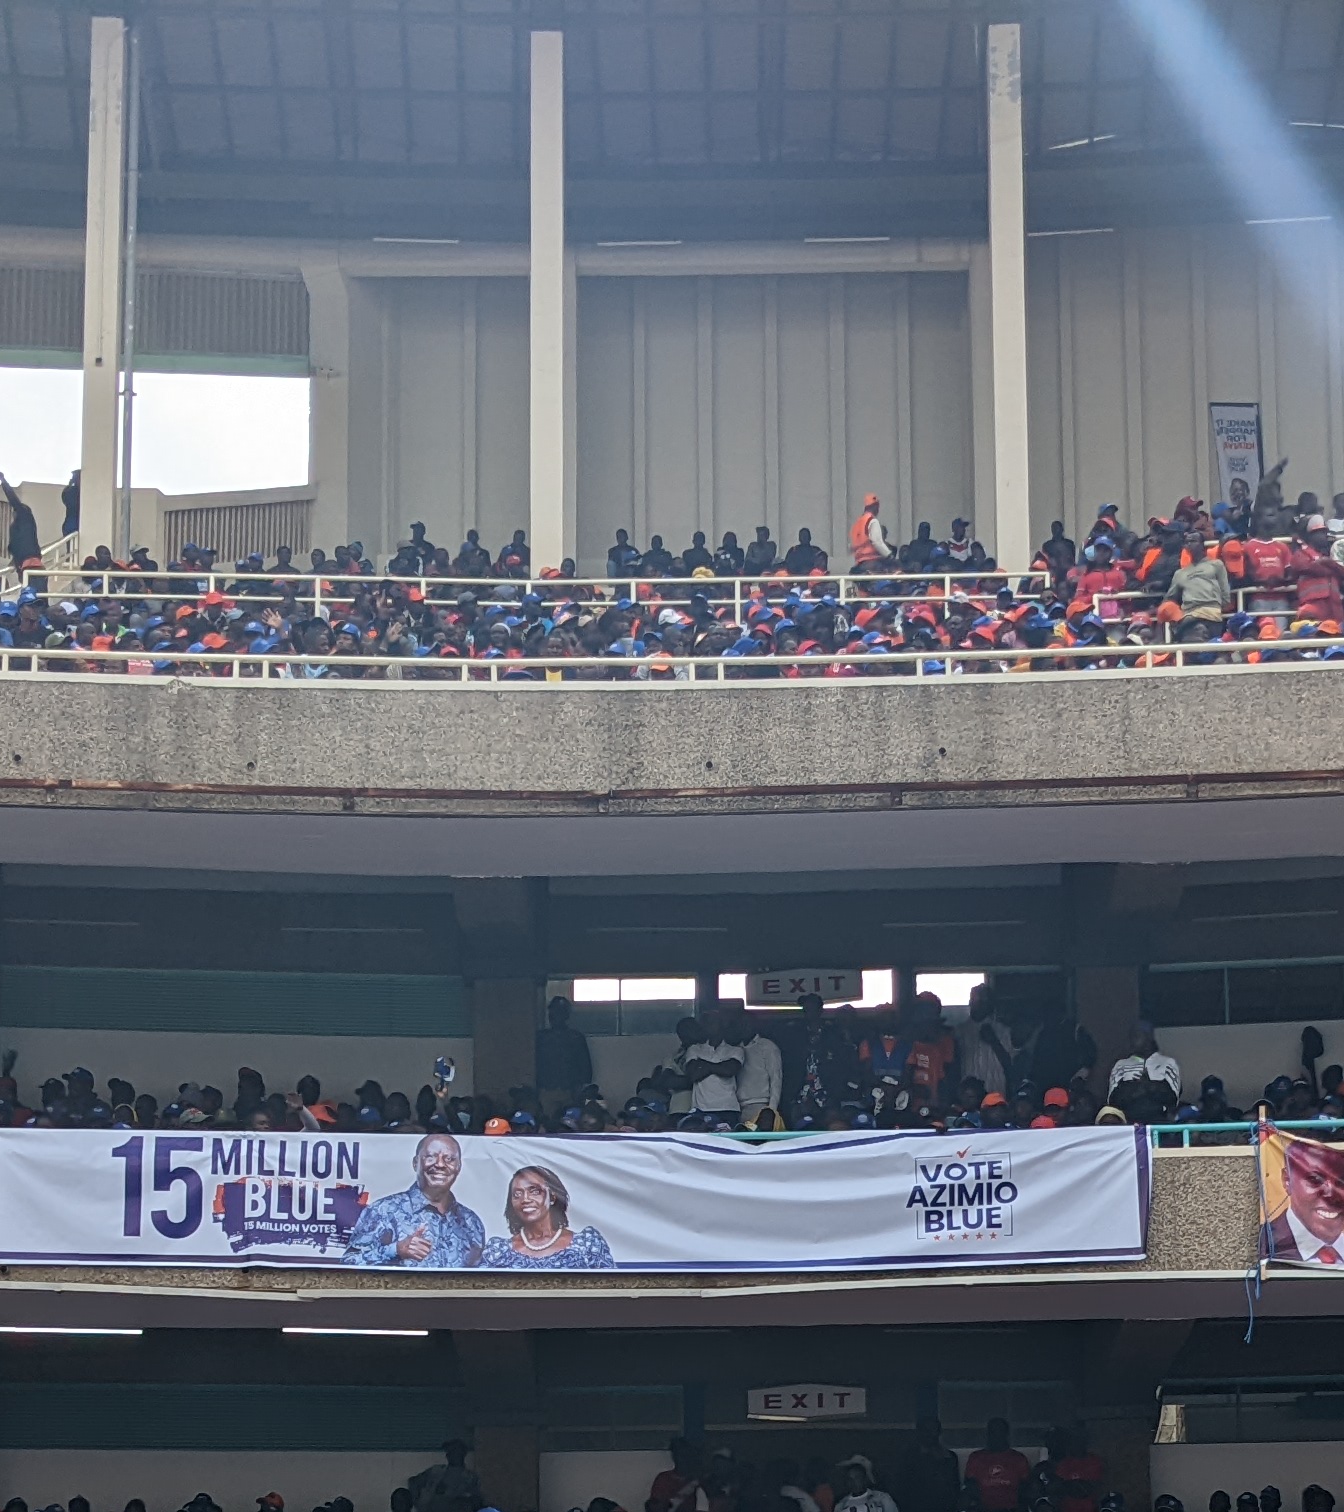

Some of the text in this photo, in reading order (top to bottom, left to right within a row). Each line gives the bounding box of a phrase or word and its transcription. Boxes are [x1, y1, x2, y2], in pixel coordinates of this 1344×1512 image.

[760, 975, 846, 995] EXIT
[919, 1160, 1003, 1183] VOTE
[111, 1135, 361, 1240] 15 MILLION
[243, 1178, 337, 1221] BLUE
[906, 1181, 1018, 1208] AZIMIO
[243, 1220, 338, 1234] 15 MILLION VOTES
[924, 1207, 1003, 1233] BLUE
[763, 1391, 852, 1410] EXIT
